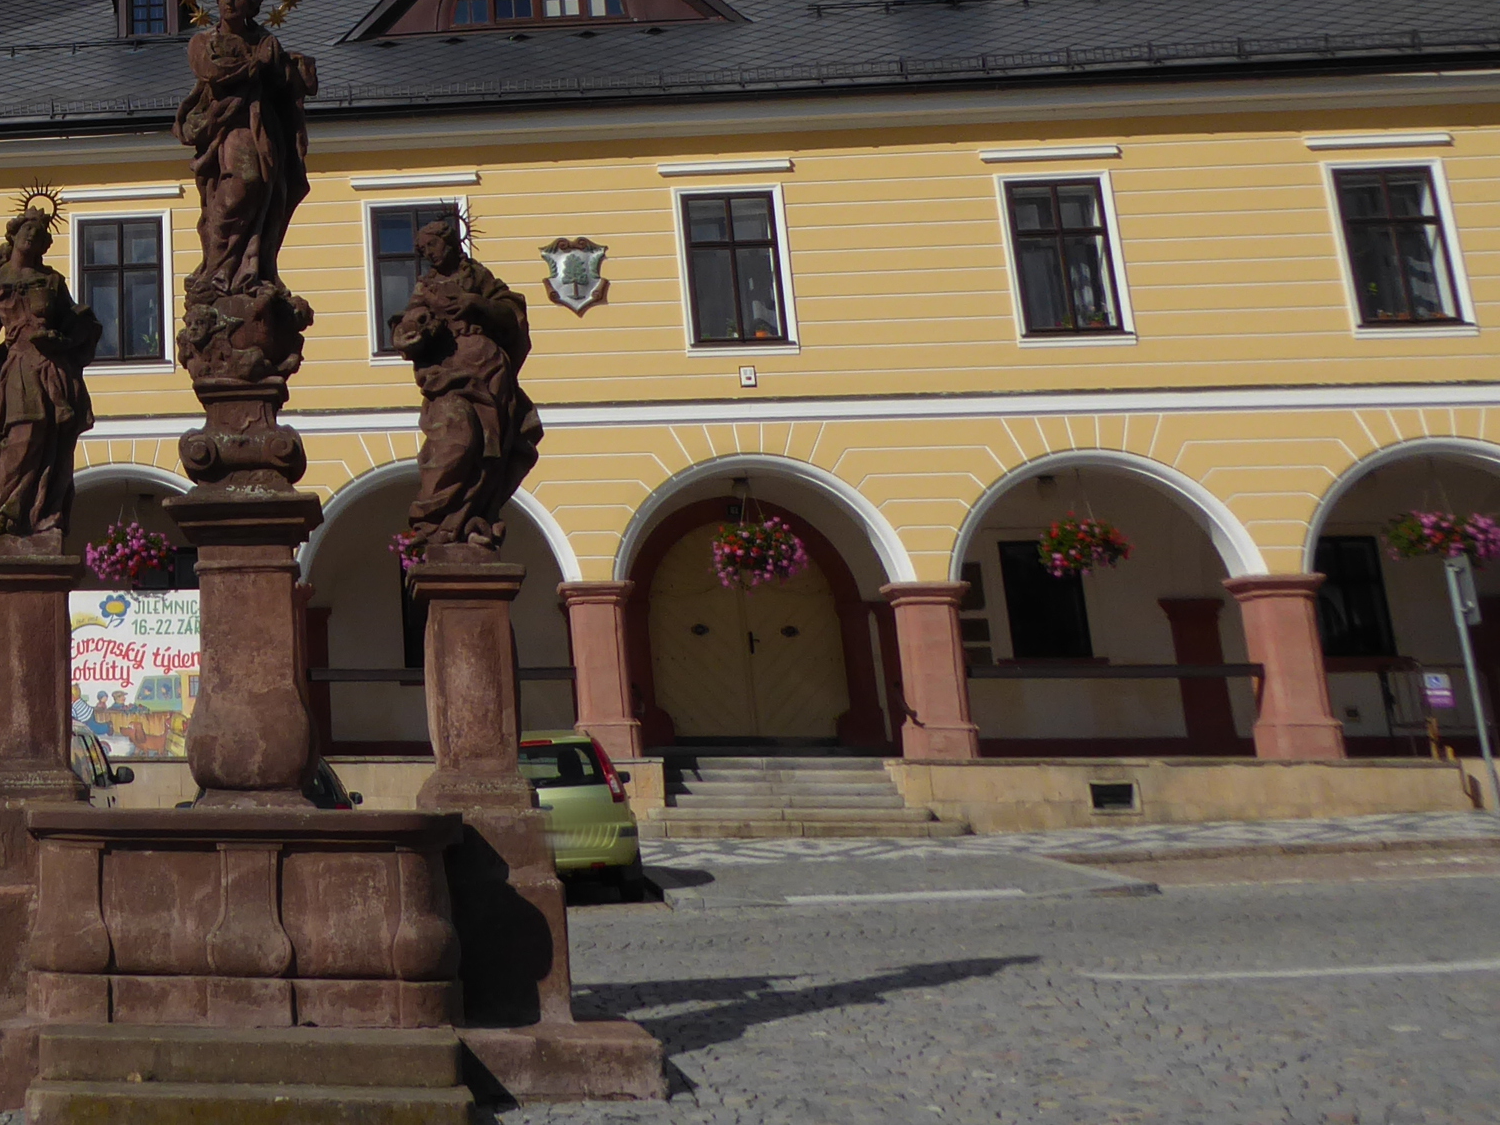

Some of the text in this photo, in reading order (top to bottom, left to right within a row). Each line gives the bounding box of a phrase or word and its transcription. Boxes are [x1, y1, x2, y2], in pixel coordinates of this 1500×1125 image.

[134, 599, 200, 615] JILEMNIC
[71, 660, 134, 688] obility
[152, 646, 202, 674] týden
